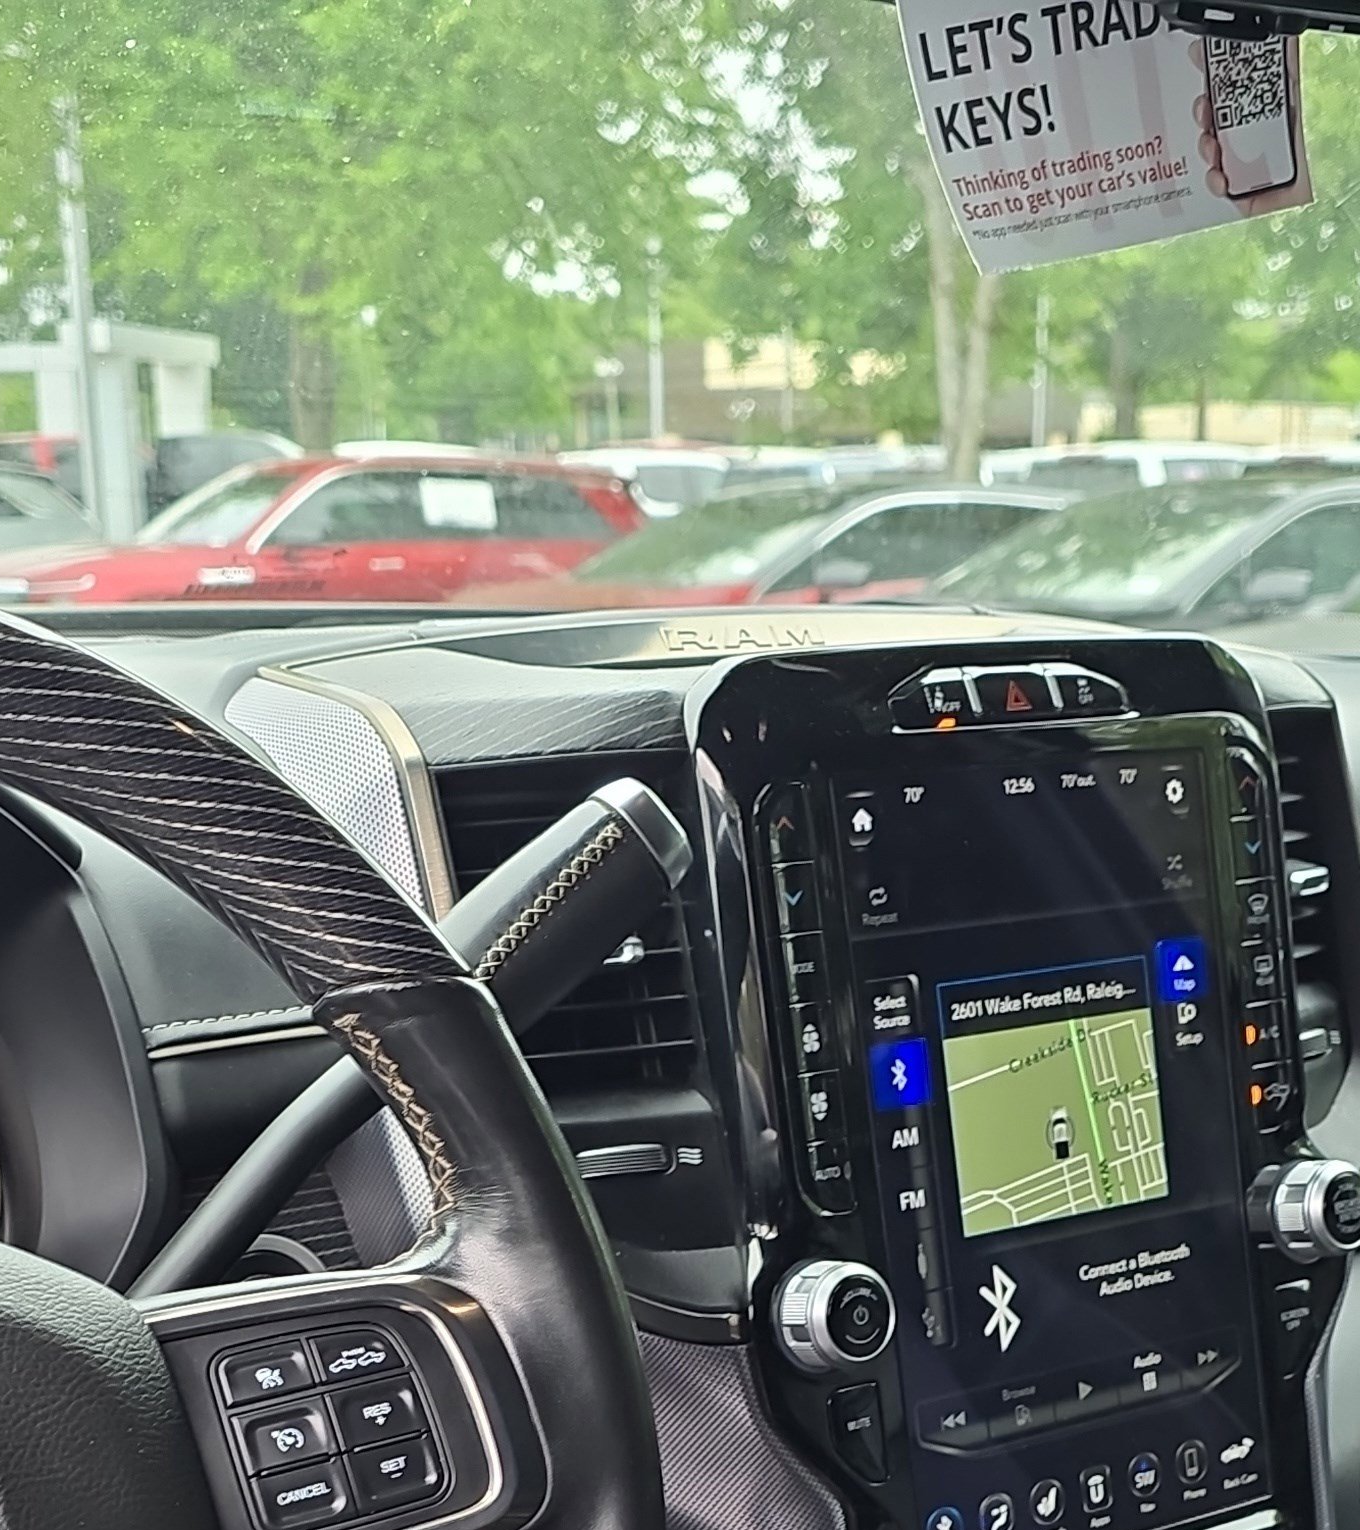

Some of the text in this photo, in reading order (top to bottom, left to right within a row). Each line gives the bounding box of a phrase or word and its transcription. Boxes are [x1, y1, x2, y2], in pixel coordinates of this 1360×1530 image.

[919, 0, 1181, 82] LET'S TRAD
[935, 83, 1056, 154] KEYS!
[953, 135, 1163, 198] Thinking of trading soon?
[962, 156, 1189, 221] Scan to get your car's value!
[658, 624, 826, 652] RAM
[873, 995, 907, 1012] Select
[951, 1001, 983, 1020] 2601
[985, 996, 1021, 1015] Wake
[1023, 989, 1063, 1010] Forest
[1064, 986, 1085, 1004] Rd,
[873, 1014, 911, 1030] Source
[892, 1127, 920, 1150] AM
[899, 1189, 926, 1212] FM
[1079, 1242, 1191, 1281] Connect a Bluetooth
[1099, 1278, 1133, 1297] Audio
[1133, 1352, 1162, 1369] Audio
[362, 1402, 392, 1420] RES
[379, 1456, 408, 1474] SET
[276, 1481, 332, 1506] CANCEL
